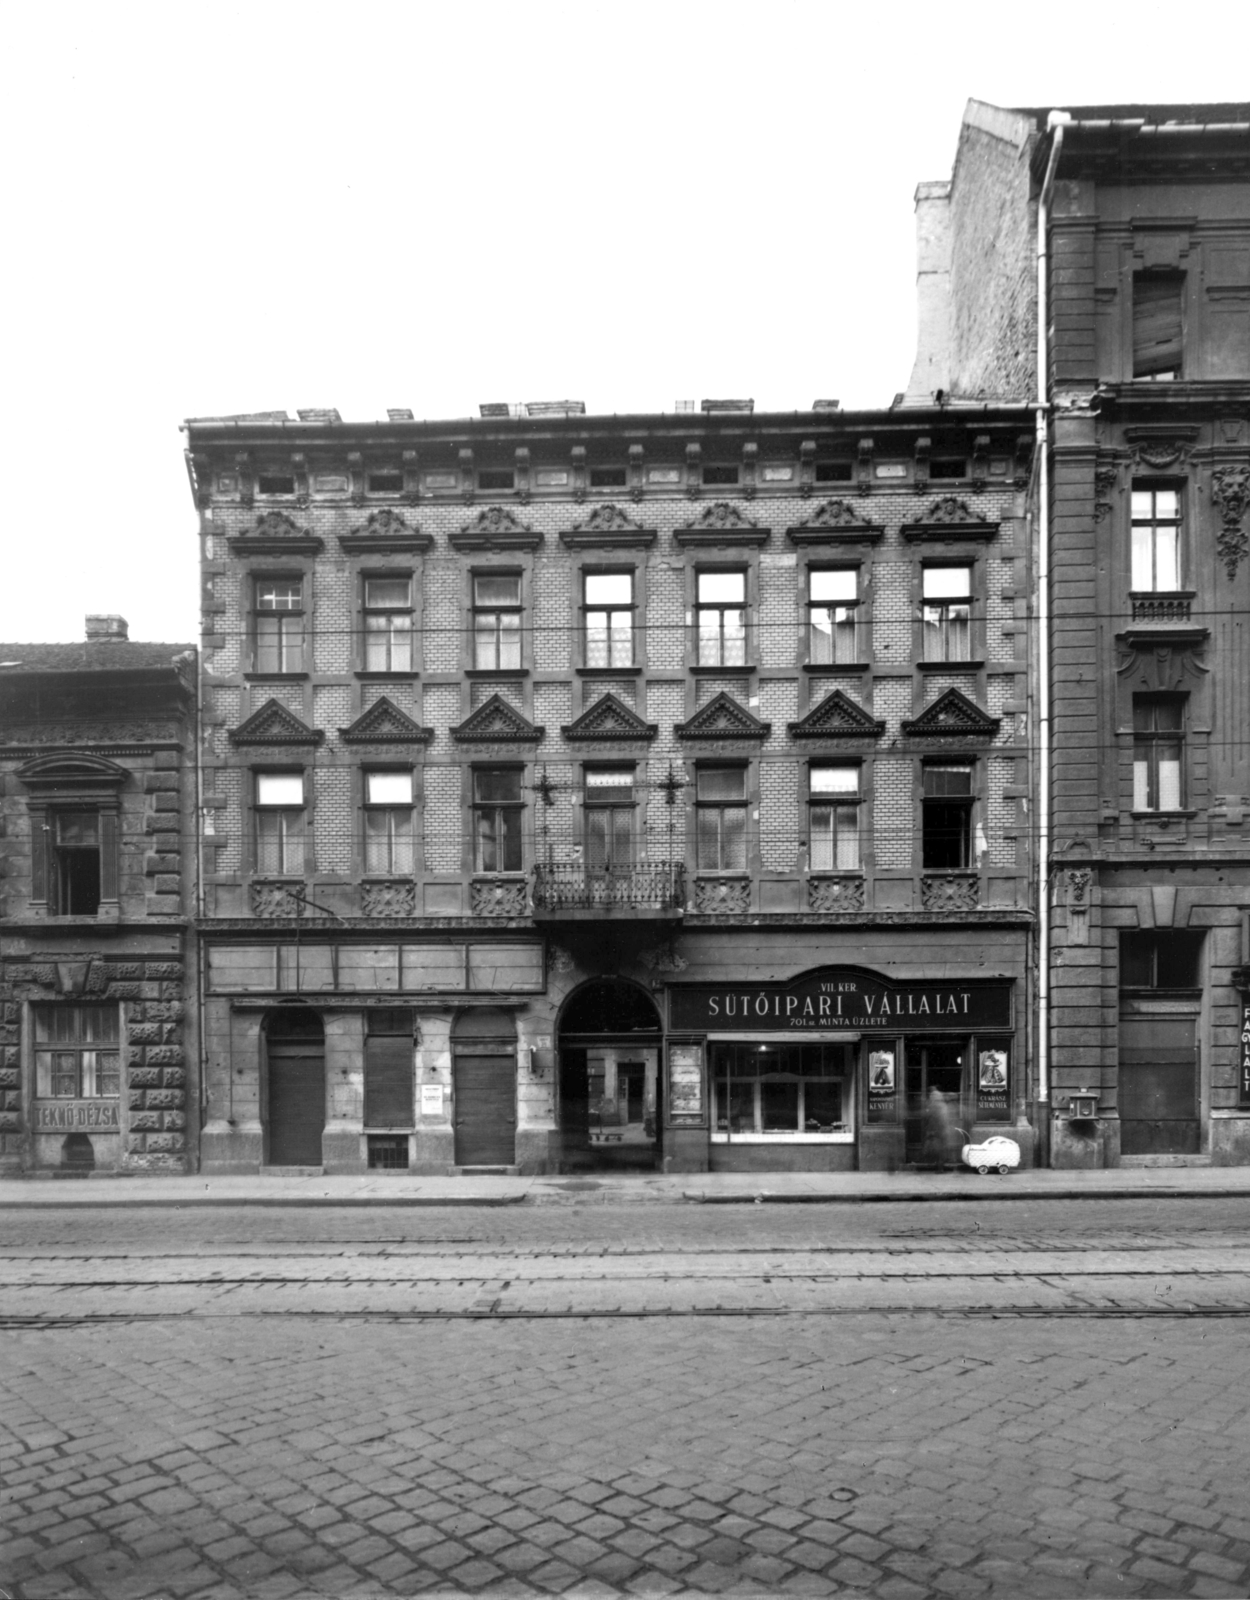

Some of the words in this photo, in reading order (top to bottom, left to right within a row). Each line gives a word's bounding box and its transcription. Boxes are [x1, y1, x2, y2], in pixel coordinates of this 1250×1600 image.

[708, 992, 842, 1016] SÜTŐIPARI
[864, 991, 971, 1015] VÁLLALAT
[819, 1017, 850, 1026] MINTA
[852, 1016, 888, 1026] ÜZLETE
